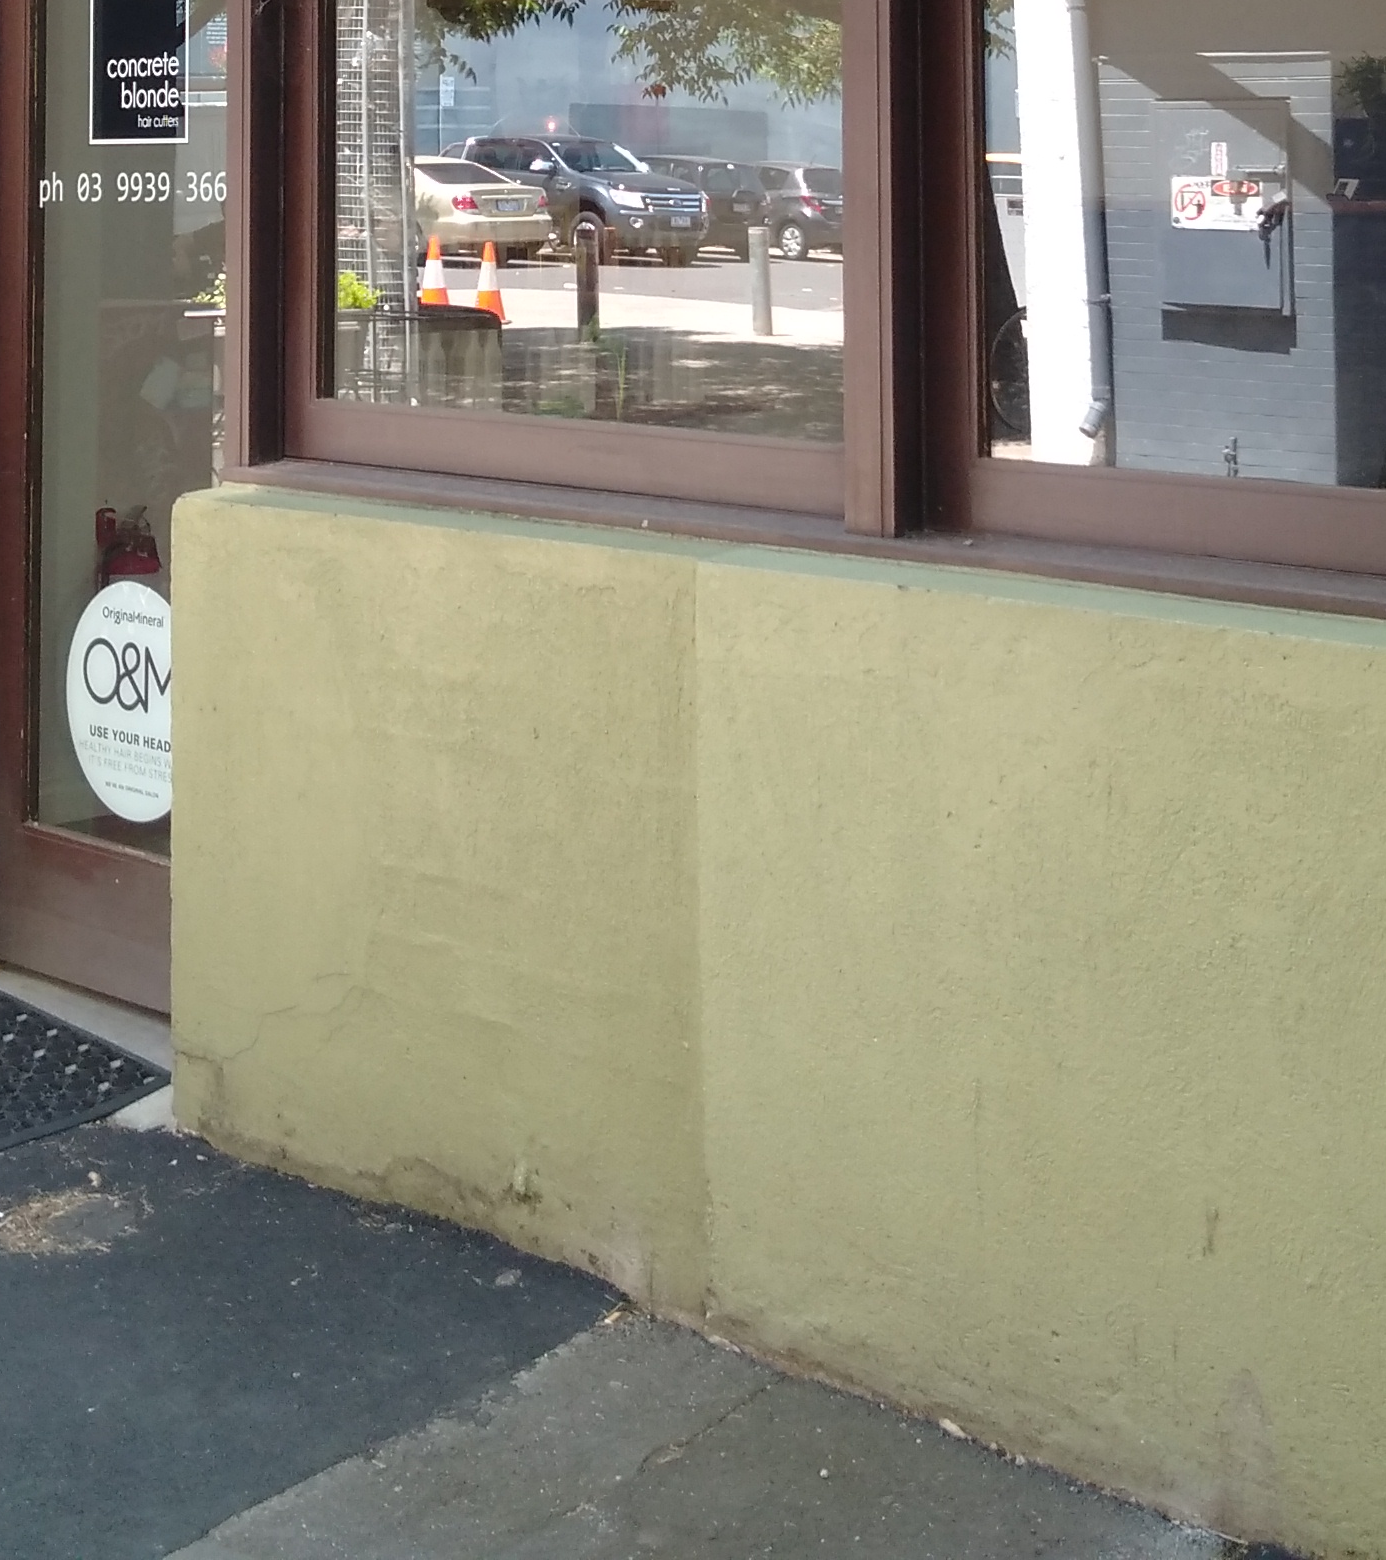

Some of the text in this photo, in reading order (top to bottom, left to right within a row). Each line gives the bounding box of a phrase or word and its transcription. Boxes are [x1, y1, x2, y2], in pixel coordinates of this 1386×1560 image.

[107, 51, 180, 78] concrete
[121, 80, 180, 109] blonde
[138, 114, 179, 128] hair cutters
[39, 171, 63, 208] ph
[77, 172, 102, 202] 03
[117, 172, 170, 202] 9939
[79, 739, 111, 755] HEALTHY
[113, 747, 132, 759] HAIR
[89, 724, 171, 753] USE YOUR HEAD
[103, 757, 122, 772] FREE
[124, 763, 147, 777] FROM
